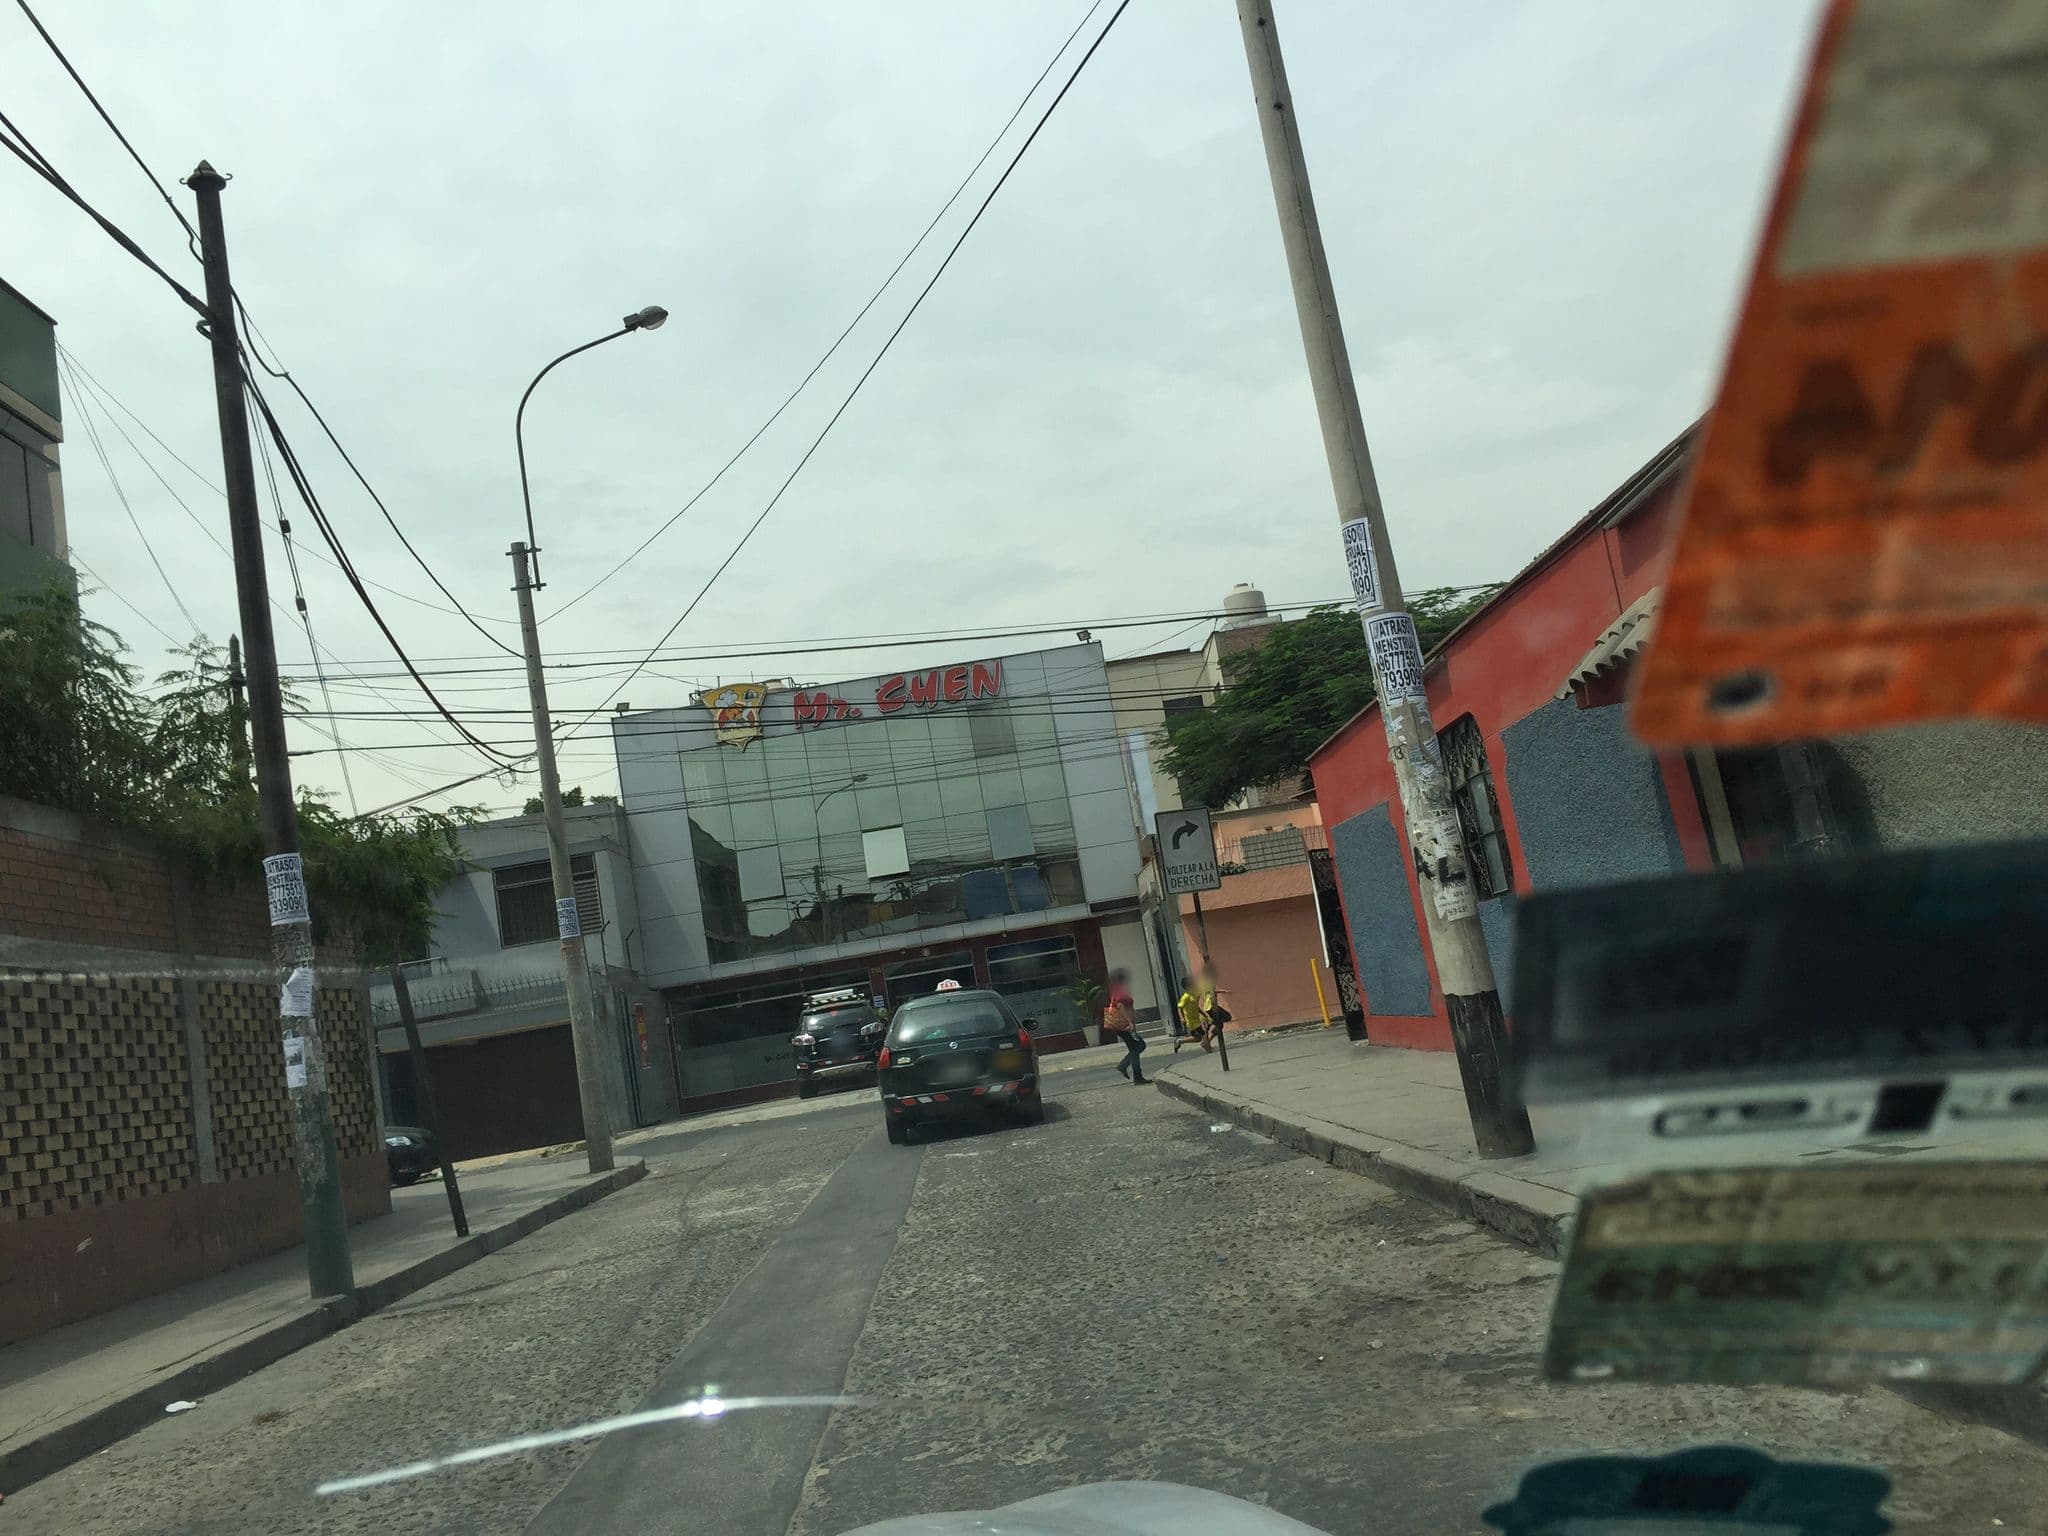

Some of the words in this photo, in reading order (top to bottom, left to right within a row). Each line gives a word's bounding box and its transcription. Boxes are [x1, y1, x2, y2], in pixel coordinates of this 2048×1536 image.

[874, 659, 1002, 714] CHEN
[1171, 872, 1215, 889] DERECHA
[940, 981, 957, 989] TAXI
